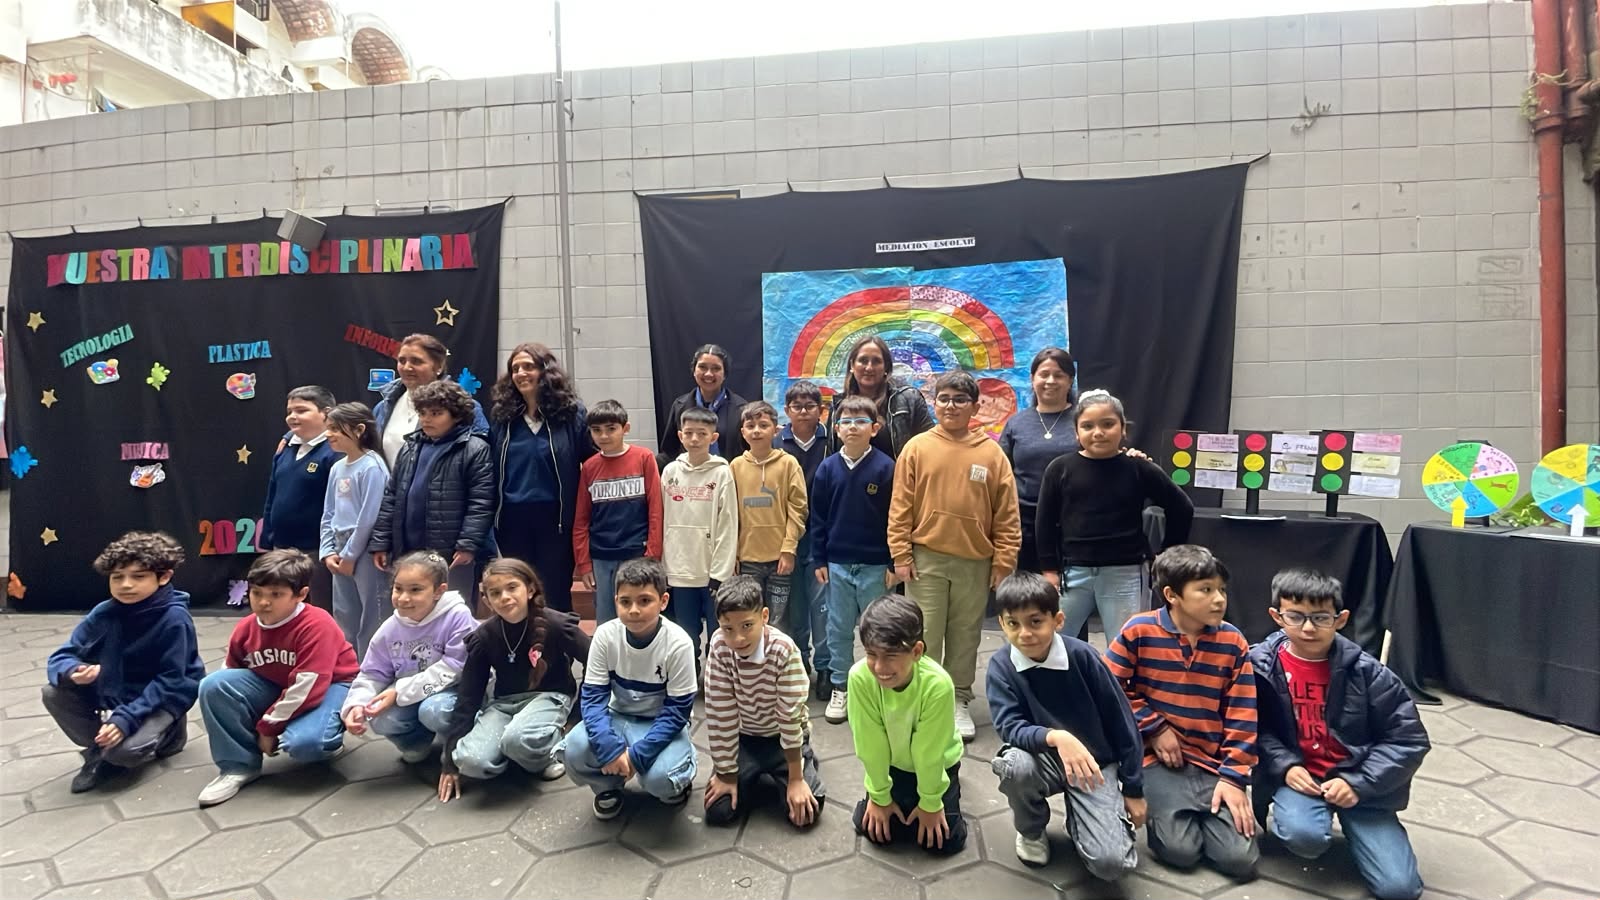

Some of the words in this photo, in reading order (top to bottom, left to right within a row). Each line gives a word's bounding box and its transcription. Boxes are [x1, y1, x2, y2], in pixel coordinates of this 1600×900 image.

[934, 238, 974, 248] ESCOLAR
[60, 323, 134, 368] TECNOLOGIA
[208, 340, 272, 364] PLASTICA
[344, 323, 401, 360] INFORM
[1294, 681, 1328, 700] LET
